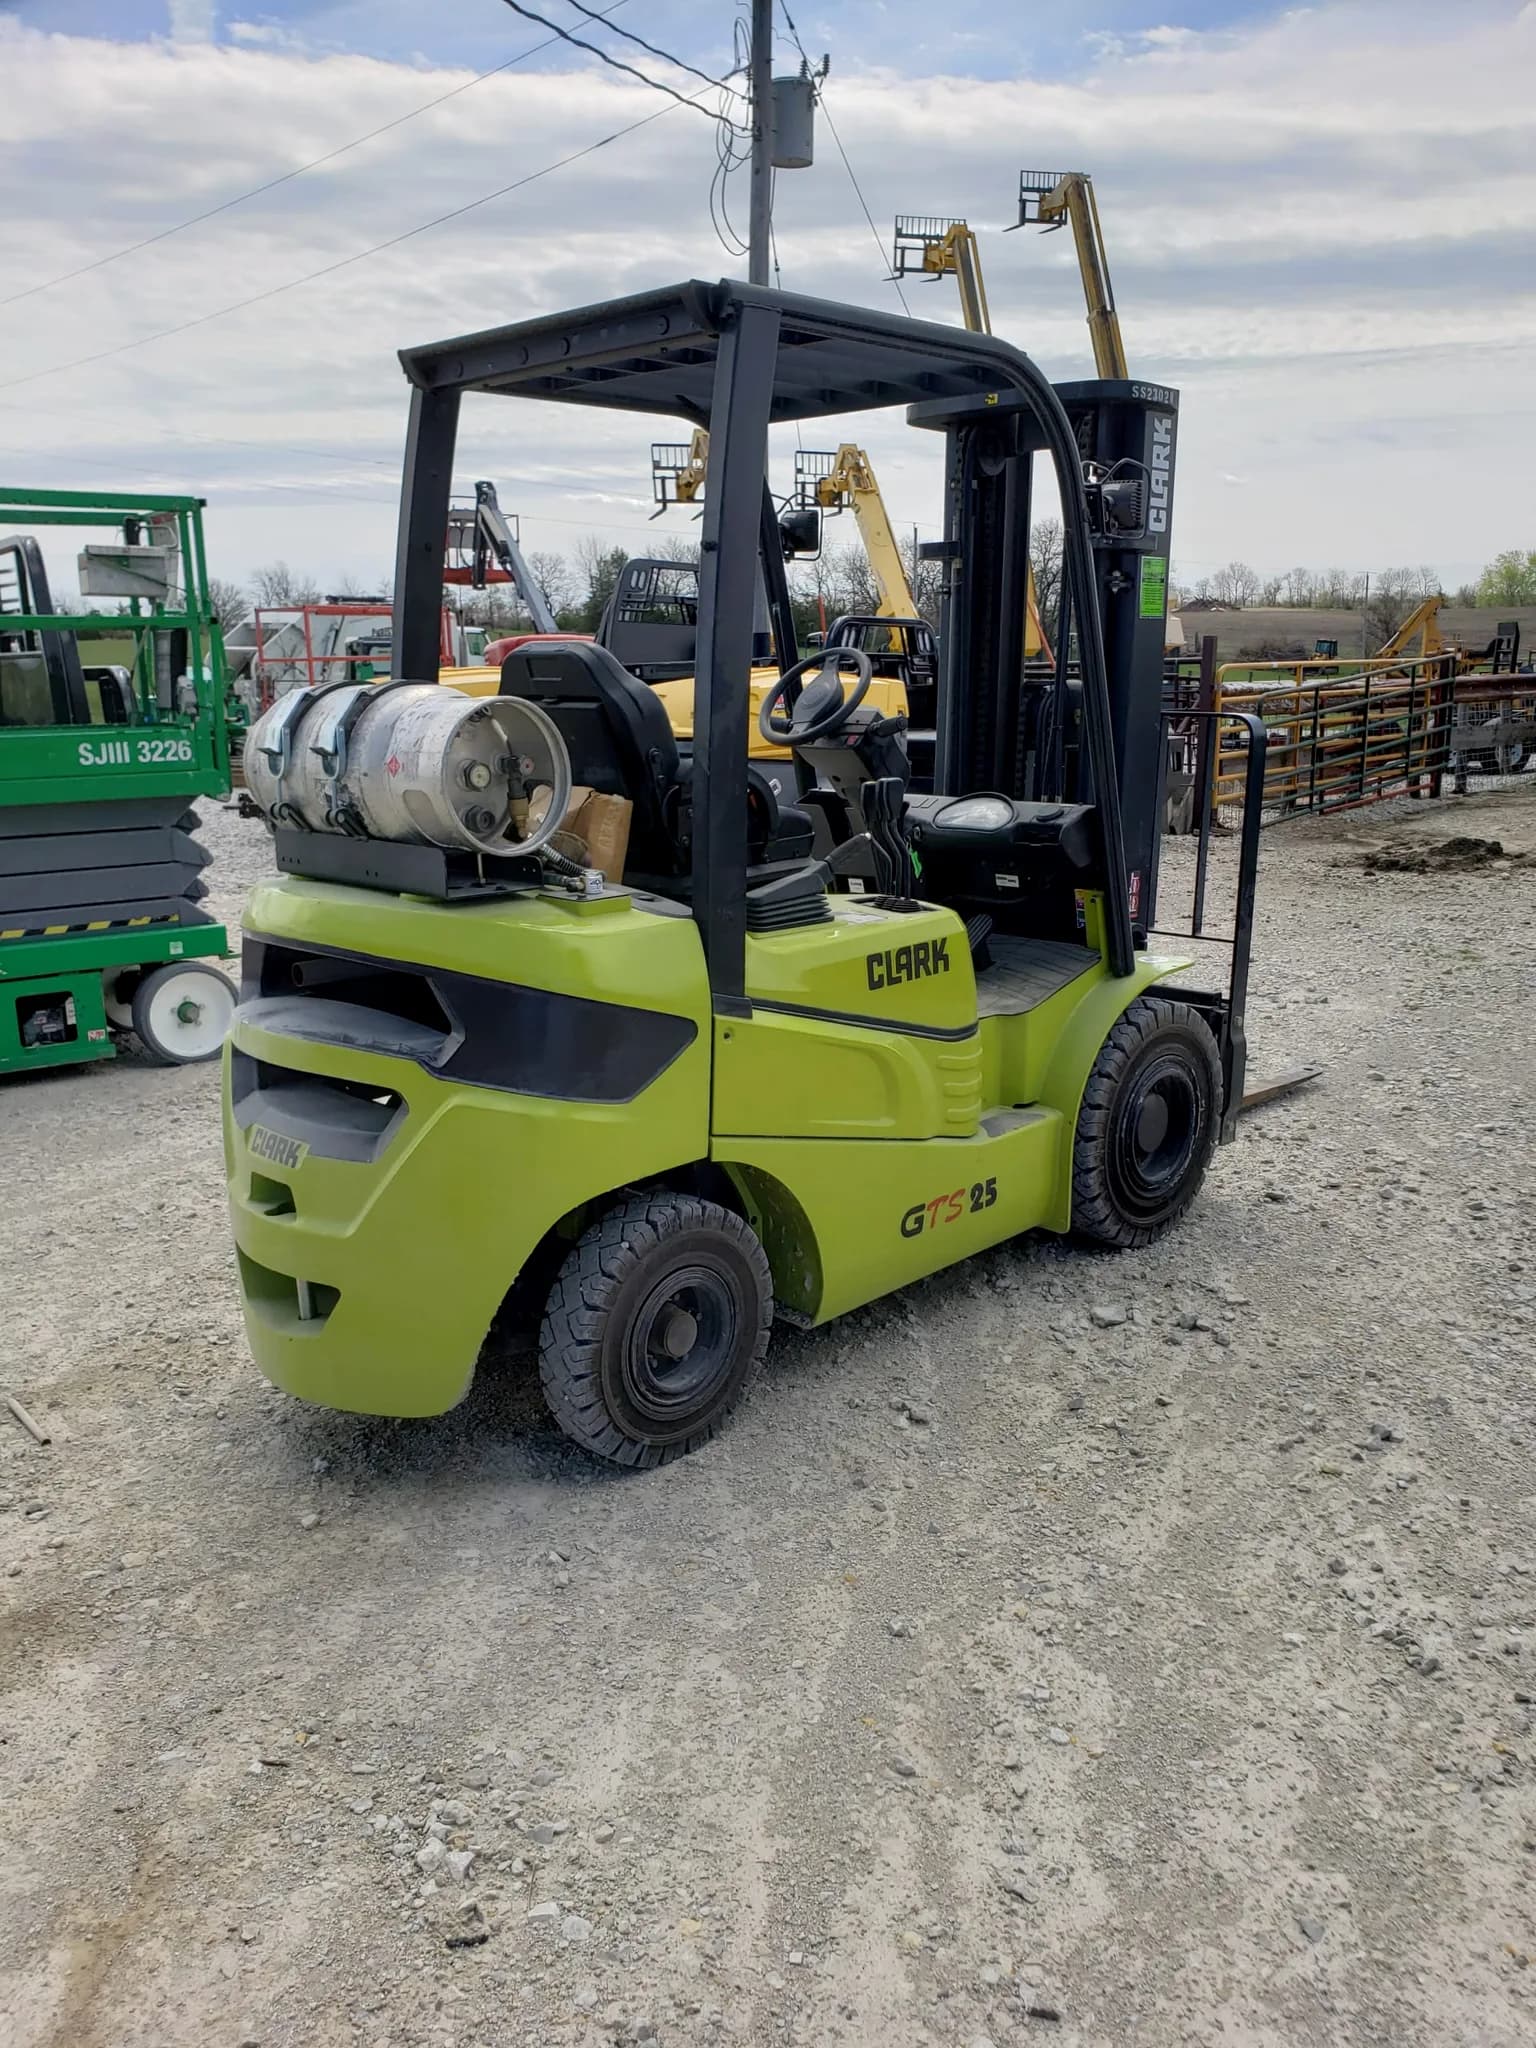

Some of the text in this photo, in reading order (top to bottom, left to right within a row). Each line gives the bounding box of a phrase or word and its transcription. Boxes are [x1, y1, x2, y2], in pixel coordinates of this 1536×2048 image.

[1149, 417, 1172, 533] CLARK
[78, 740, 192, 765] SJIII 3226
[866, 937, 949, 991] CLARK
[251, 1127, 301, 1168] CLARK
[901, 1176, 998, 1238] GTS 25
